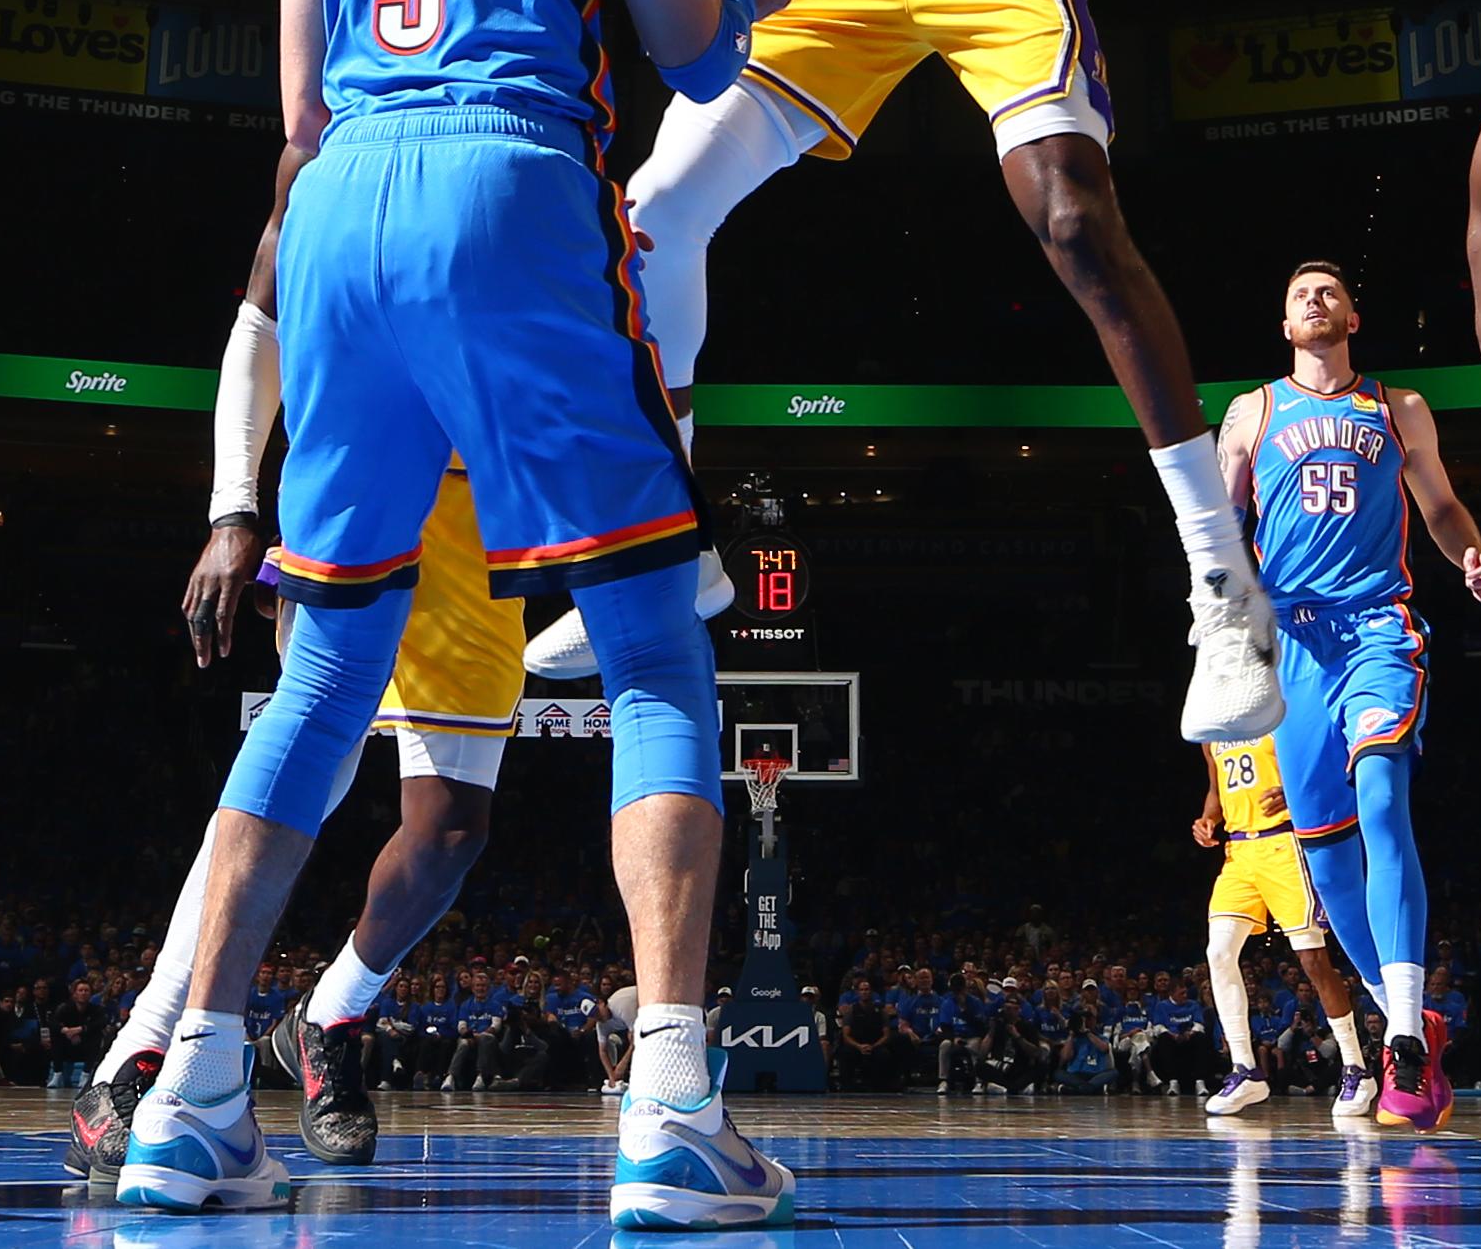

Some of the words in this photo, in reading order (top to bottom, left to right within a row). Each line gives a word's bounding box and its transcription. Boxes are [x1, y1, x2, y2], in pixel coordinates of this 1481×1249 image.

[159, 23, 264, 87] LOUD
[23, 91, 71, 112] THE
[79, 97, 192, 124] THUNDER
[228, 112, 282, 132] EXIT
[1204, 121, 1277, 142] BRING
[1286, 114, 1330, 134] THE
[1336, 104, 1451, 130] THUNDER
[65, 369, 127, 394] Sprite
[786, 393, 846, 419] Sprite
[1271, 416, 1385, 466] THUNDER
[1299, 462, 1357, 515] 55
[750, 550, 797, 571] 7:47
[758, 572, 792, 611] 18
[750, 629, 806, 640] TISSOT
[535, 718, 572, 728] HOME
[583, 718, 611, 729] HOM
[1223, 753, 1256, 790] 28
[758, 895, 777, 912] GET
[758, 913, 777, 929] THE
[762, 930, 781, 950] App
[750, 986, 782, 999] Google
[721, 1024, 810, 1049] KIA
